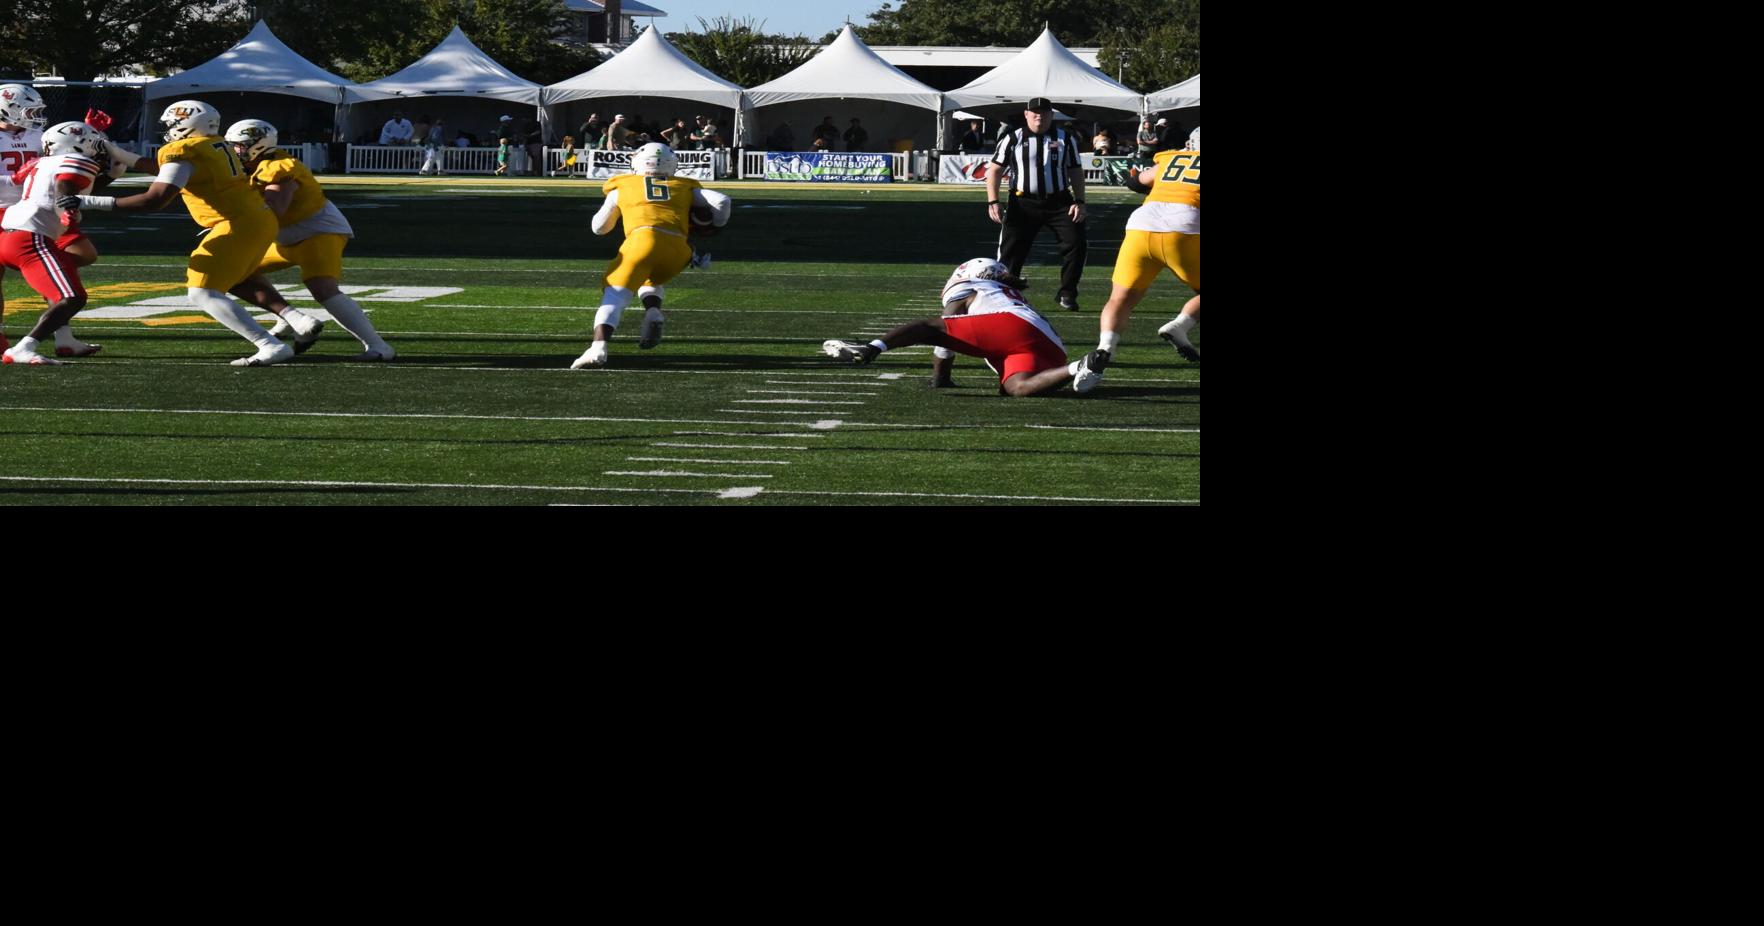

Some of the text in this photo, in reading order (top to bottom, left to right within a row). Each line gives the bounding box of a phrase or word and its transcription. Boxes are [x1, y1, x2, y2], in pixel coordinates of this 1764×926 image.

[818, 160, 887, 168] HOMEBUYING
[1161, 154, 1200, 186] 65
[644, 175, 671, 201] 6
